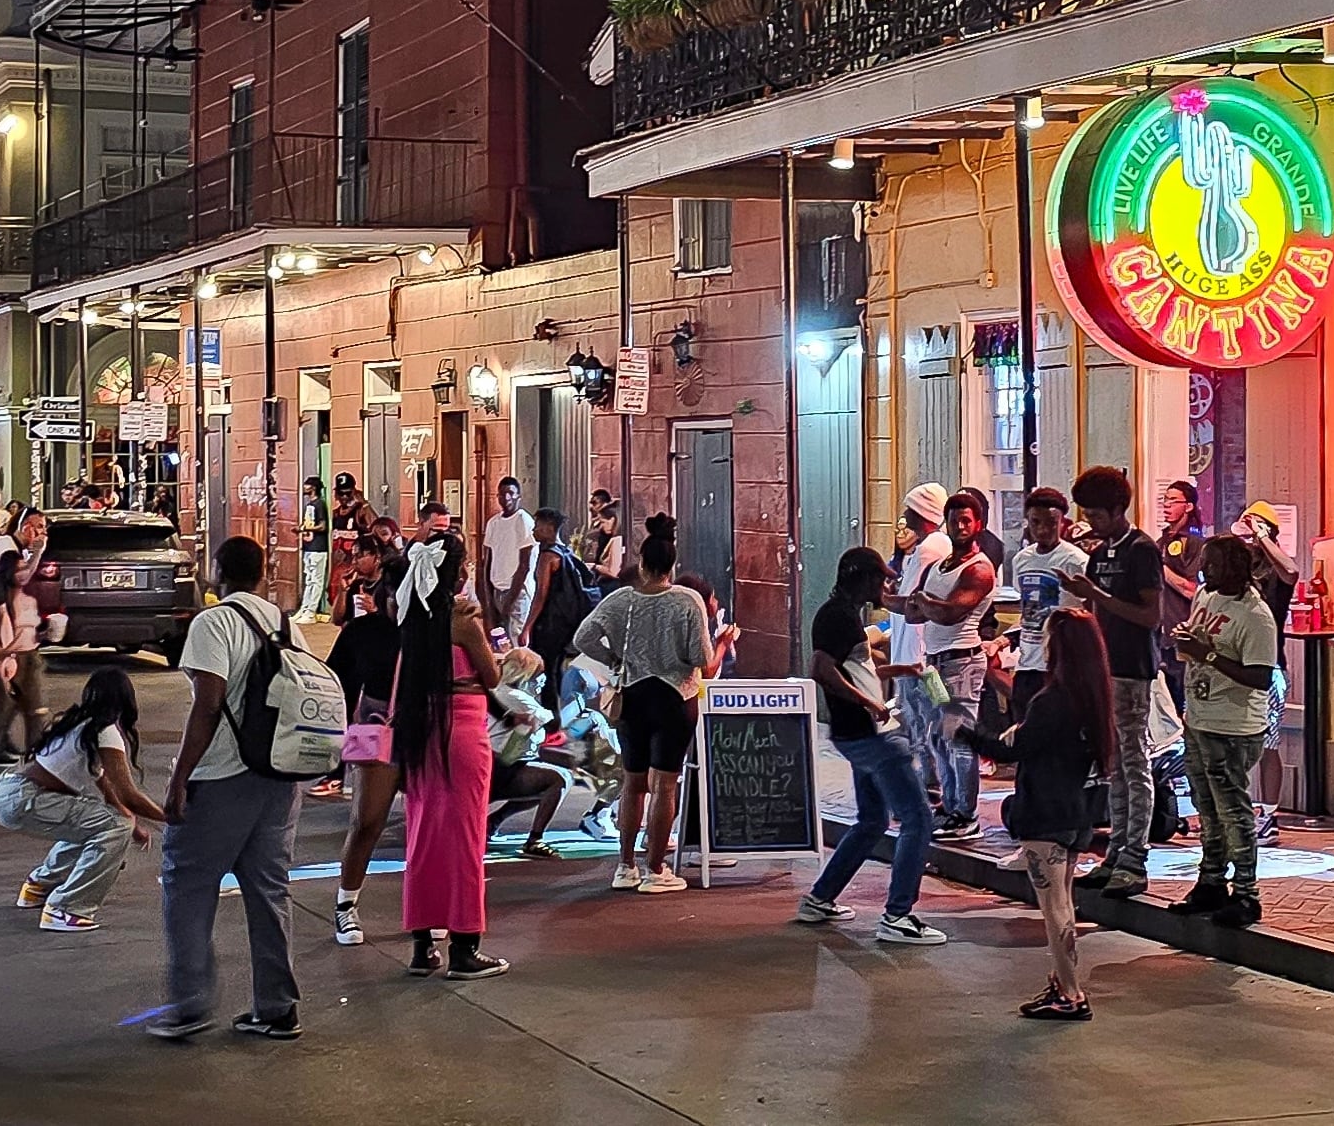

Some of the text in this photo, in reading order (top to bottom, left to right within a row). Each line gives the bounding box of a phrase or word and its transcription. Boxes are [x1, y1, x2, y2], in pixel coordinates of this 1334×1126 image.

[1114, 119, 1170, 215] LIVE LIFE
[1252, 123, 1316, 217] GRANDE
[1112, 245, 1334, 360] CANTINA
[1164, 250, 1272, 295] HUGE ASS
[47, 426, 65, 434] ONE
[713, 694, 800, 708] BUD LIGHT
